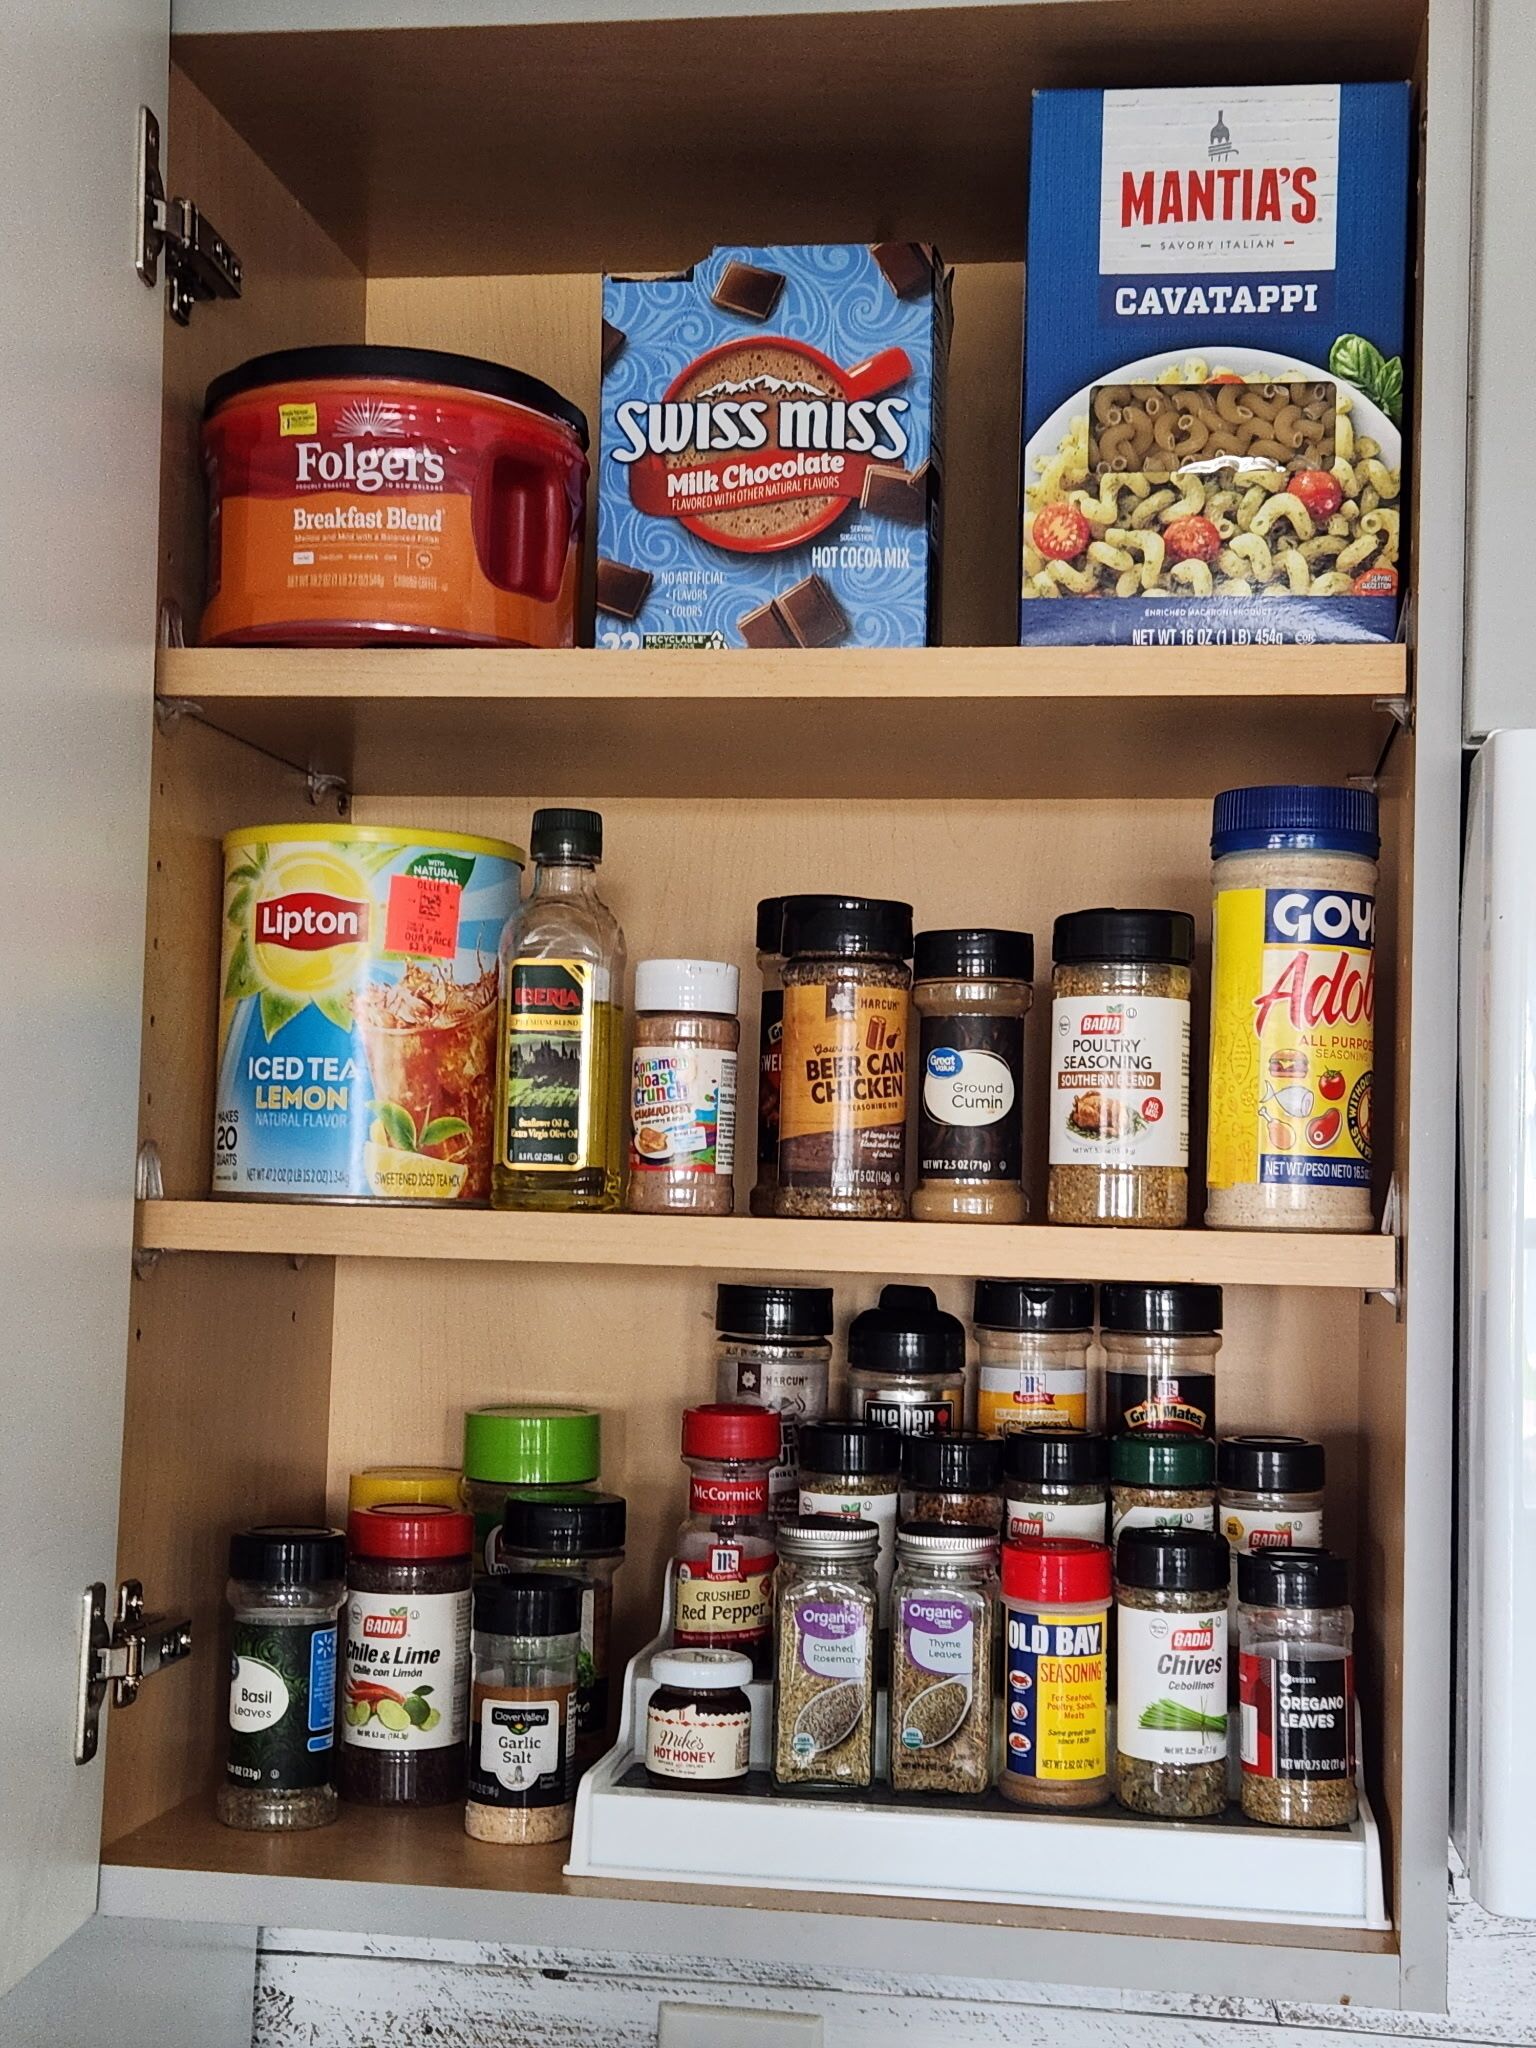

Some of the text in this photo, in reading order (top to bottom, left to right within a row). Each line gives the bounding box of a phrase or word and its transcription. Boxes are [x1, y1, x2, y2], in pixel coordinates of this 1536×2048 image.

[1121, 167, 1317, 228] MANTIA'S
[1160, 239, 1275, 250] SAVORY ITALIAN
[1115, 285, 1318, 315] CAVATAPPI
[611, 401, 767, 462] SWISS
[296, 442, 445, 492] Folgers
[667, 452, 846, 497] Milk Chocolate
[672, 476, 840, 511] FLAVORED WITH OTHER NATURAL FLAVORS
[293, 507, 441, 532] Breakfast Blend
[811, 546, 910, 569] HOT COCOA MIX
[661, 571, 726, 585] NO ARTIFICIAL
[672, 589, 708, 601] FLAVORS
[671, 606, 703, 618] COLORS
[1145, 608, 1186, 617] ENRICHED
[645, 635, 704, 644] RECYCLABLE
[1132, 631, 1153, 645] NET
[1157, 631, 1175, 645] WT
[1180, 630, 1193, 644] 16
[1197, 630, 1213, 645] OZ
[1217, 629, 1227, 645] (1
[1231, 629, 1251, 645] LB)
[413, 866, 459, 879] NATURAL
[263, 906, 358, 941] Lipton
[515, 987, 581, 1011] IBERIA
[1082, 1017, 1120, 1031] BADIA
[1072, 1039, 1141, 1053] POULTRY
[1299, 1035, 1327, 1047] ALL
[930, 1055, 956, 1066] Great
[1063, 1056, 1152, 1069] SEASONING
[1315, 1048, 1368, 1062] SEASONING
[249, 1057, 356, 1081] ICED TEA
[866, 1051, 904, 1075] CAN
[952, 1082, 1003, 1094] Ground
[1061, 1074, 1114, 1087] SOUTHERN
[256, 1086, 348, 1111] LEMON
[951, 1094, 1003, 1109] Cumin
[255, 1112, 347, 1128] NATURAL FLAVOR
[217, 1126, 238, 1150] 20
[932, 1160, 943, 1169] WT
[943, 1160, 956, 1170] 2.5
[957, 1160, 968, 1170] OZ
[969, 1160, 991, 1172] (71g)
[1264, 1161, 1285, 1176] NET
[1331, 1165, 1353, 1178] NETO
[374, 1172, 449, 1187] SWEETENED ICED TEA
[866, 1170, 875, 1183] OZ
[765, 1376, 804, 1386] HARCUM
[870, 1407, 936, 1435] weber
[1163, 1405, 1203, 1425] Mates
[694, 1483, 763, 1502] McCormick
[1012, 1521, 1040, 1535] BADIA
[1251, 1535, 1289, 1547] BADIA
[696, 1589, 751, 1602] CRUSHED
[682, 1602, 766, 1624] Red Pepper
[803, 1609, 857, 1627] Organic
[909, 1603, 963, 1621] Organic
[365, 1618, 404, 1635] BADIA
[929, 1638, 961, 1650] Thyme
[1008, 1619, 1100, 1656] OLD BAY
[1174, 1632, 1211, 1646] BADIA
[346, 1639, 441, 1665] Chile & Lime
[813, 1643, 853, 1654] Crushed
[928, 1650, 962, 1660] Leaves
[813, 1654, 861, 1664] Rosemary
[1157, 1654, 1222, 1676] Chives
[372, 1668, 390, 1678] con
[392, 1668, 423, 1678] Limón
[1040, 1661, 1102, 1684] SEASONING
[241, 1688, 272, 1704] Basil
[1280, 1696, 1344, 1711] OREGANO
[234, 1704, 272, 1718] Leaves
[495, 1711, 546, 1721] Clover Valley
[1280, 1713, 1335, 1728] LEAVES
[498, 1736, 541, 1749] Garlic
[660, 1729, 704, 1750] Mike's
[502, 1751, 532, 1763] Salt
[654, 1745, 715, 1763] HOT HONEY
